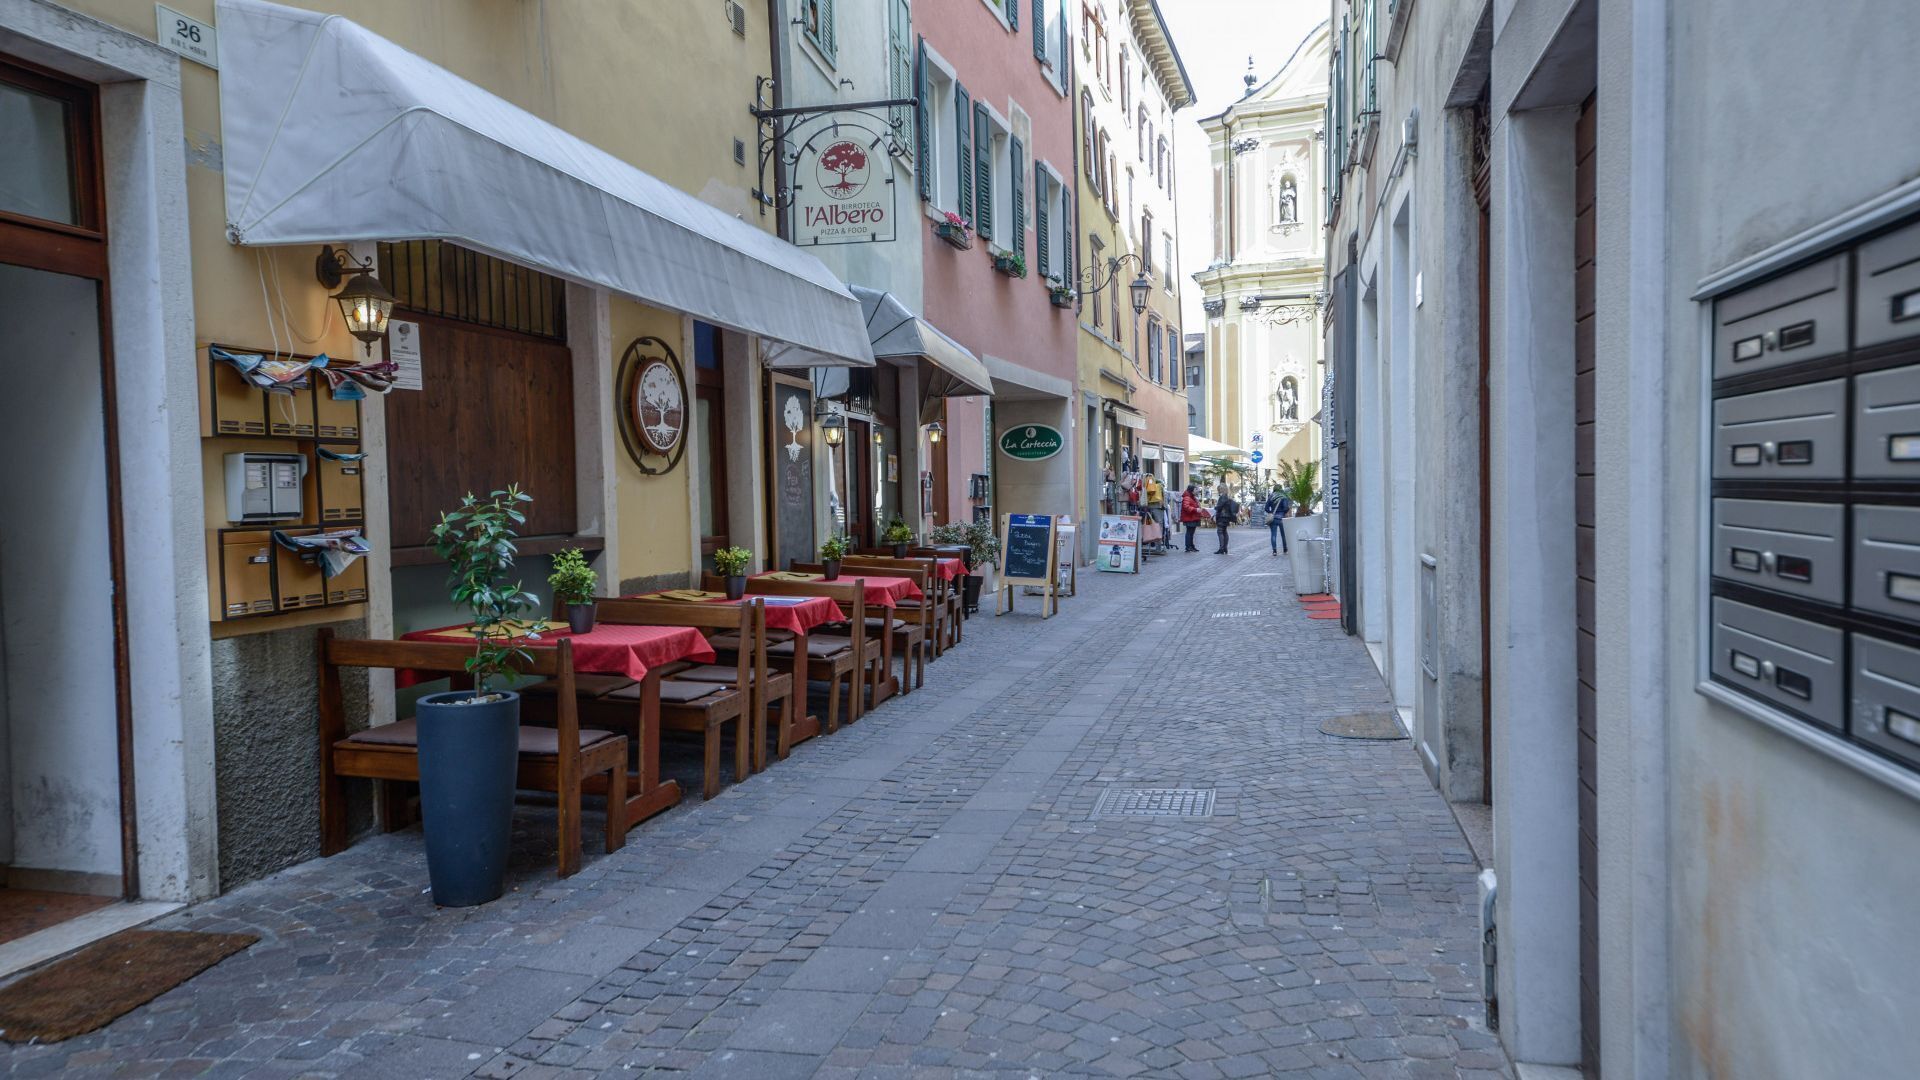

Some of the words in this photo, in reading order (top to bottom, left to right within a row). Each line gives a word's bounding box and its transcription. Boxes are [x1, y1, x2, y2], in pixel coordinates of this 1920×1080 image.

[176, 19, 201, 43] 26
[841, 201, 880, 210] BIRROTECA
[805, 204, 884, 227] l'Albero
[820, 228, 840, 236] PIZZA
[848, 226, 868, 234] FOOD
[1005, 438, 1017, 449] La
[1331, 464, 1340, 510] VIAGGI
